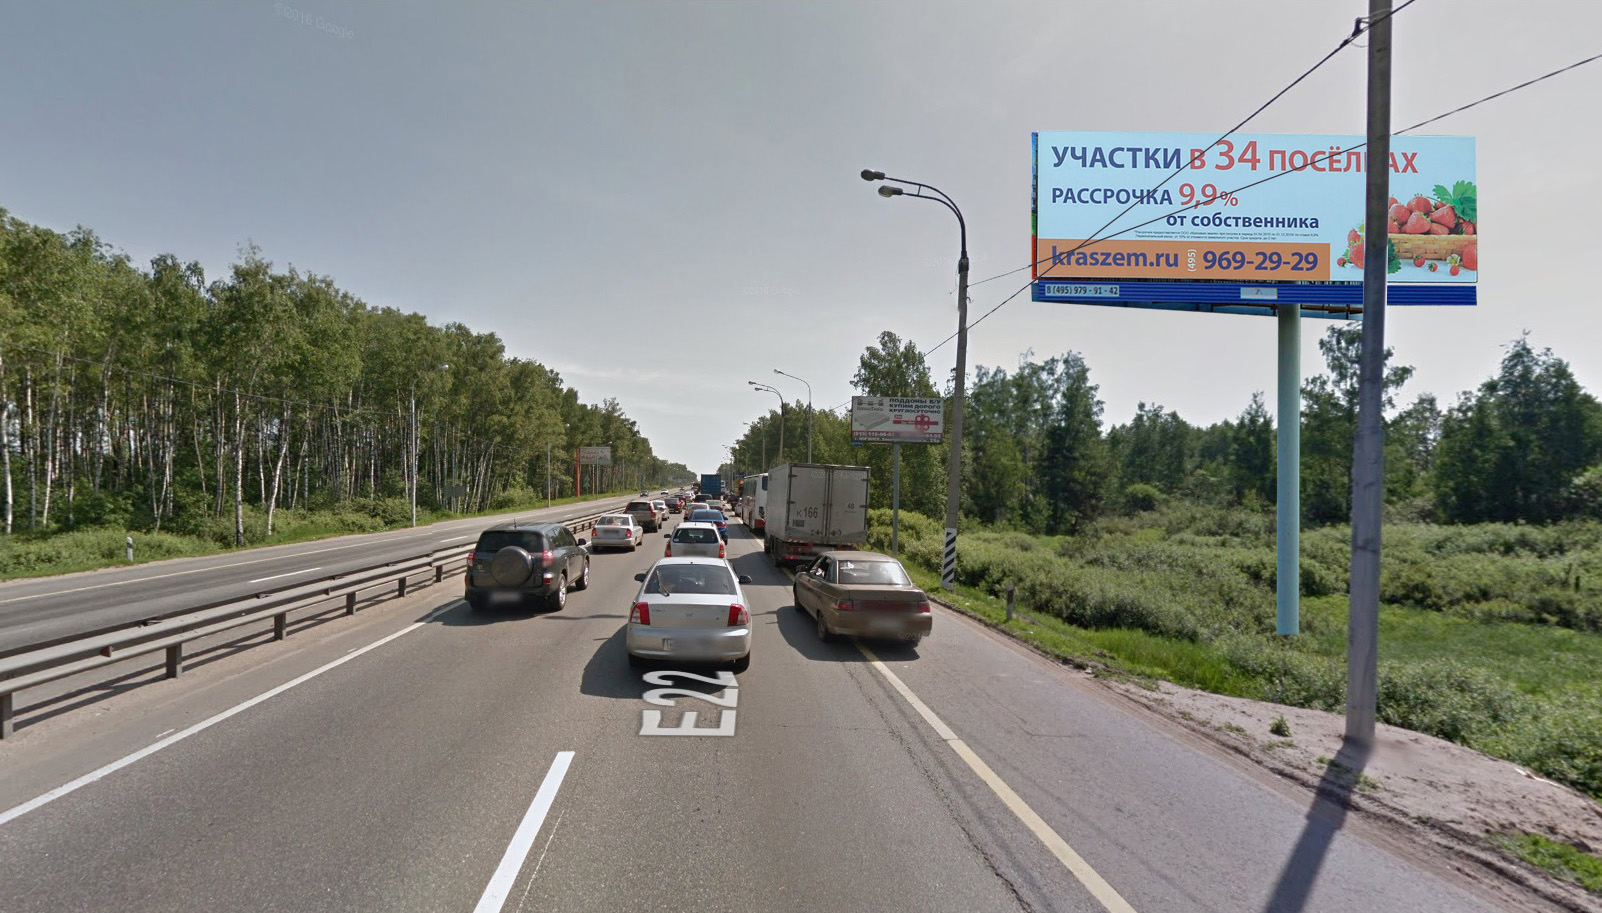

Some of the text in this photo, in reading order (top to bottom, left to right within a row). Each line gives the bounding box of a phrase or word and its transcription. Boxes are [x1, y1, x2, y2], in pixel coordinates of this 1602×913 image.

[1051, 146, 1181, 170] УЧАСТКИ
[1215, 139, 1261, 171] 34
[1269, 146, 1418, 173] ПОСЁЛАХ
[1052, 183, 1239, 210] РАССРОЧКА 9,9%
[1166, 211, 1319, 229] от собственника
[1051, 245, 1318, 272] kraszem.ru (495) 969-29-29
[1053, 285, 1072, 295] (495)
[1074, 286, 1087, 295] 979
[803, 507, 819, 519] 166
[847, 502, 855, 510] 48
